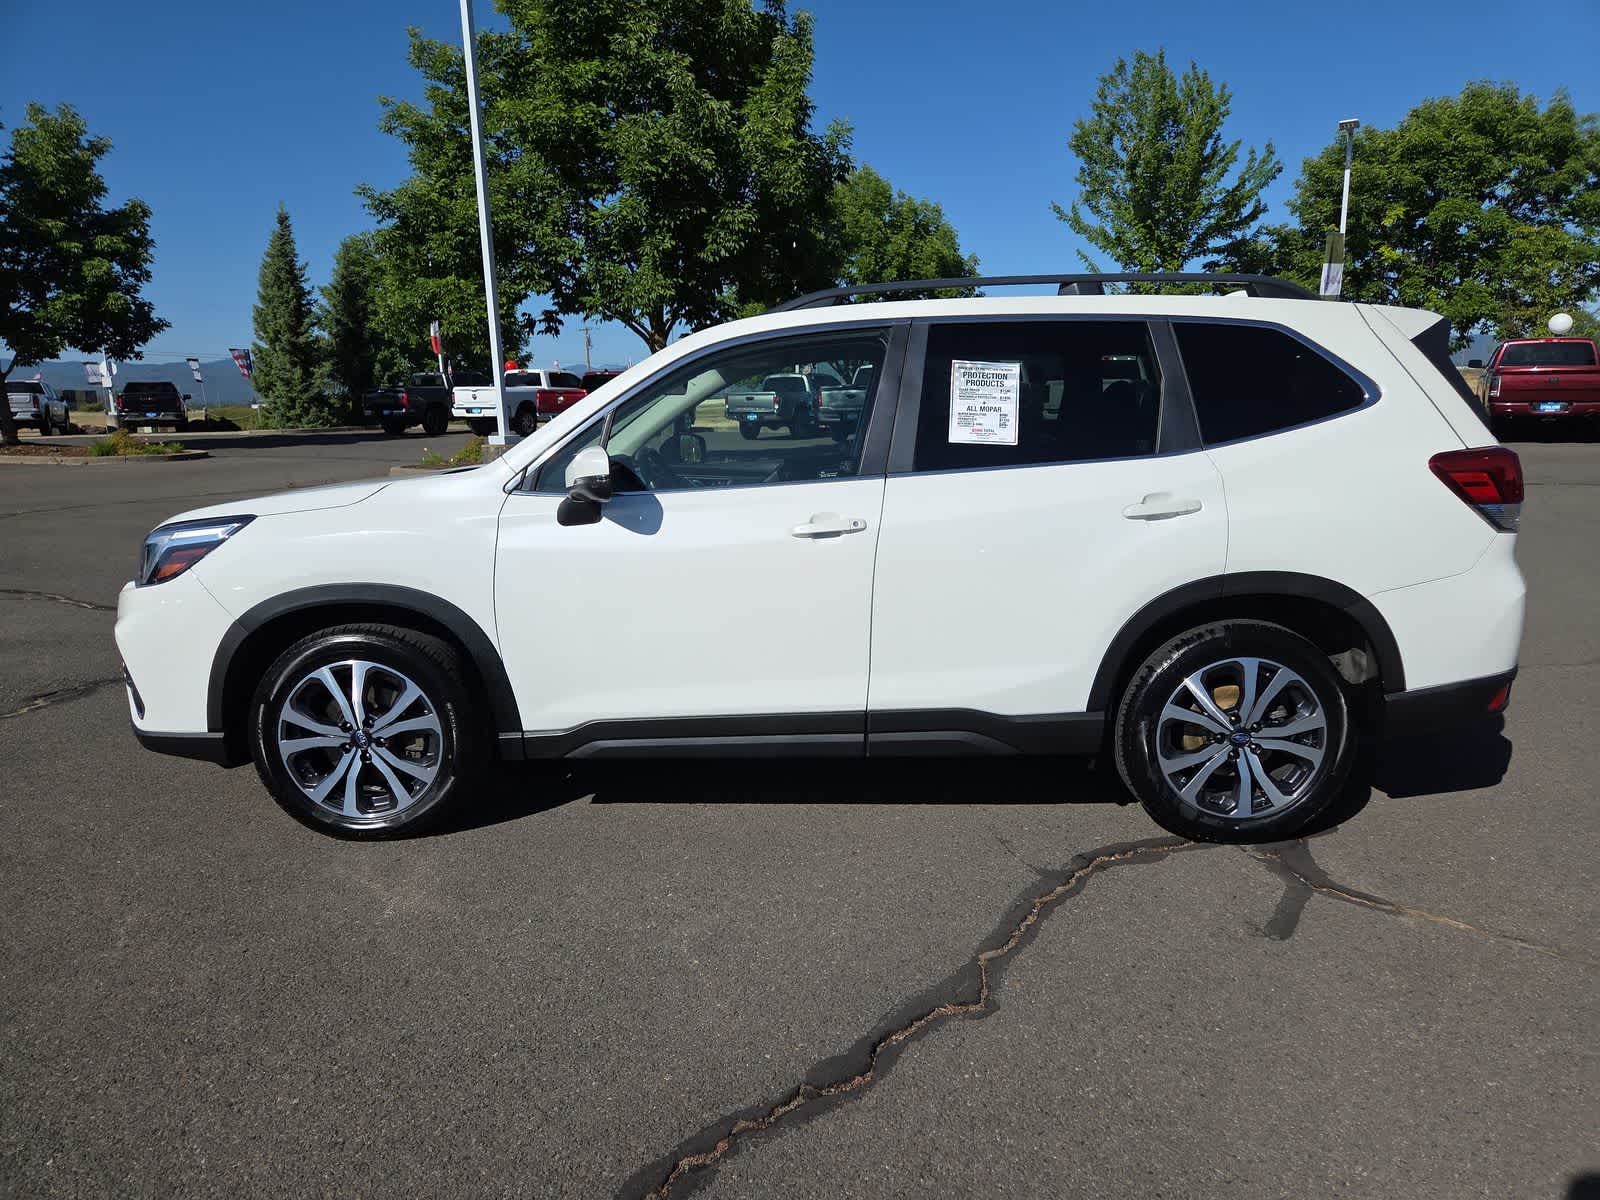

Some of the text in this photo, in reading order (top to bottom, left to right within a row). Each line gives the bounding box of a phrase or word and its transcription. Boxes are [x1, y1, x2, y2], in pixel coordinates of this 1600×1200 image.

[962, 371, 1008, 380] PROTECTION
[965, 379, 1005, 388] PRODUCTS
[979, 405, 1002, 413] MOPAR
